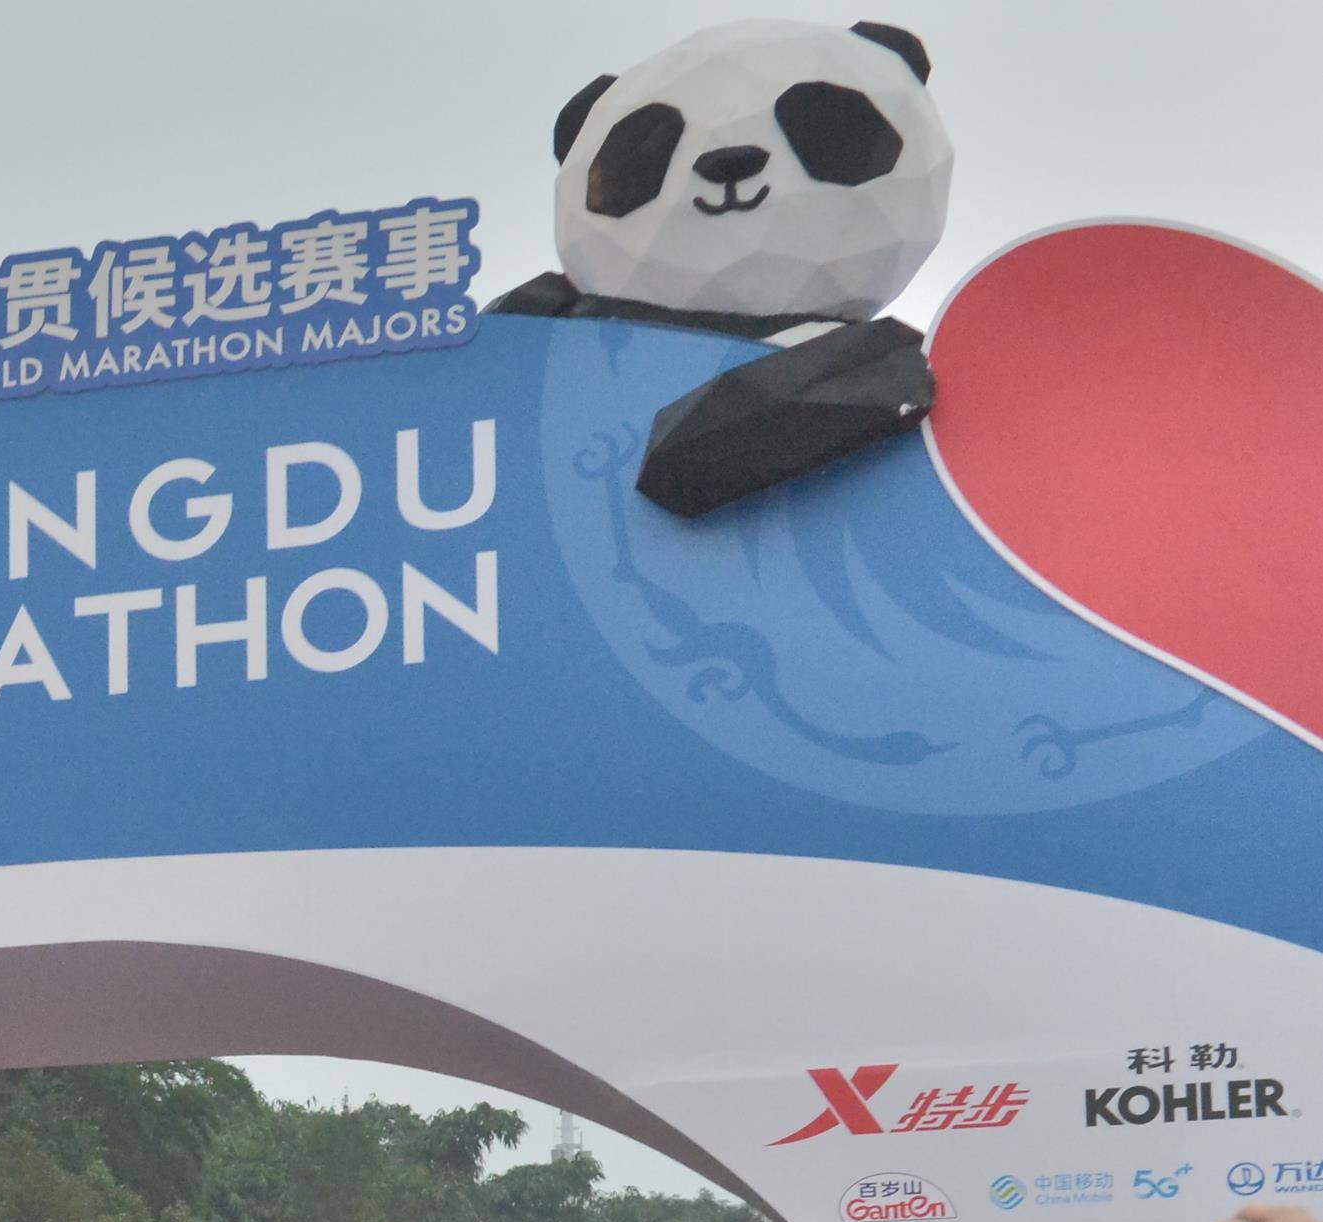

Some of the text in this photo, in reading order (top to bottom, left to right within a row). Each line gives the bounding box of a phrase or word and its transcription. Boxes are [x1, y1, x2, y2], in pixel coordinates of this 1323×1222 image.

[59, 326, 284, 381] MARATHON
[302, 304, 466, 353] MAJORS
[1127, 1043, 1238, 1074] 科勒
[890, 1083, 1029, 1134] 特步
[1085, 1079, 1288, 1128] KOHLER
[859, 1180, 923, 1198] 百岁山
[1035, 1172, 1114, 1191] 中国移动
